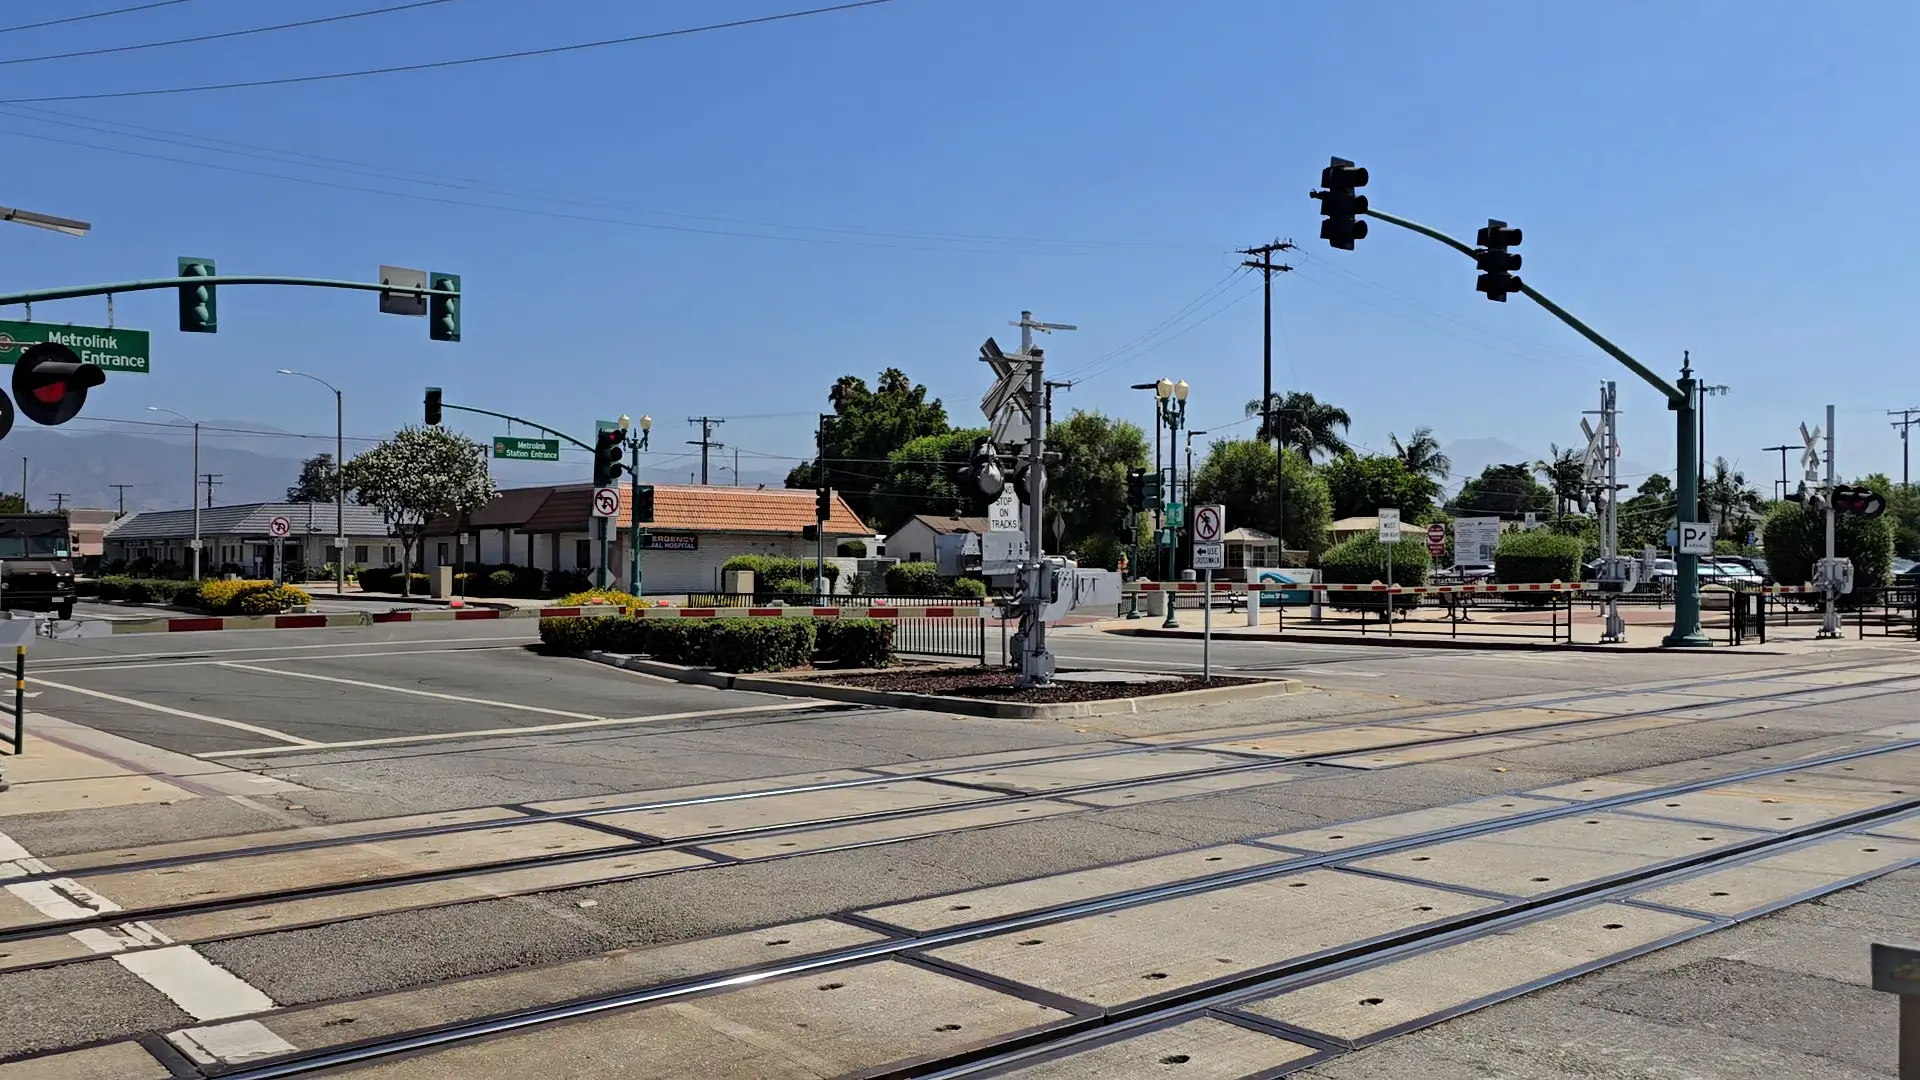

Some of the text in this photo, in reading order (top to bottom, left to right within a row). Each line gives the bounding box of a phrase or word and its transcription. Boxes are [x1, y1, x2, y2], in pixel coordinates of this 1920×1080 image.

[48, 331, 118, 349] Metrolink
[81, 350, 146, 367] Entrance
[517, 441, 546, 450] Metrolink
[531, 451, 558, 459] Entrance
[996, 497, 1012, 505] STOP
[999, 508, 1009, 517] ON
[992, 520, 1017, 529] TRACKS
[652, 535, 695, 543] ERGENCY
[1207, 547, 1218, 555] USE
